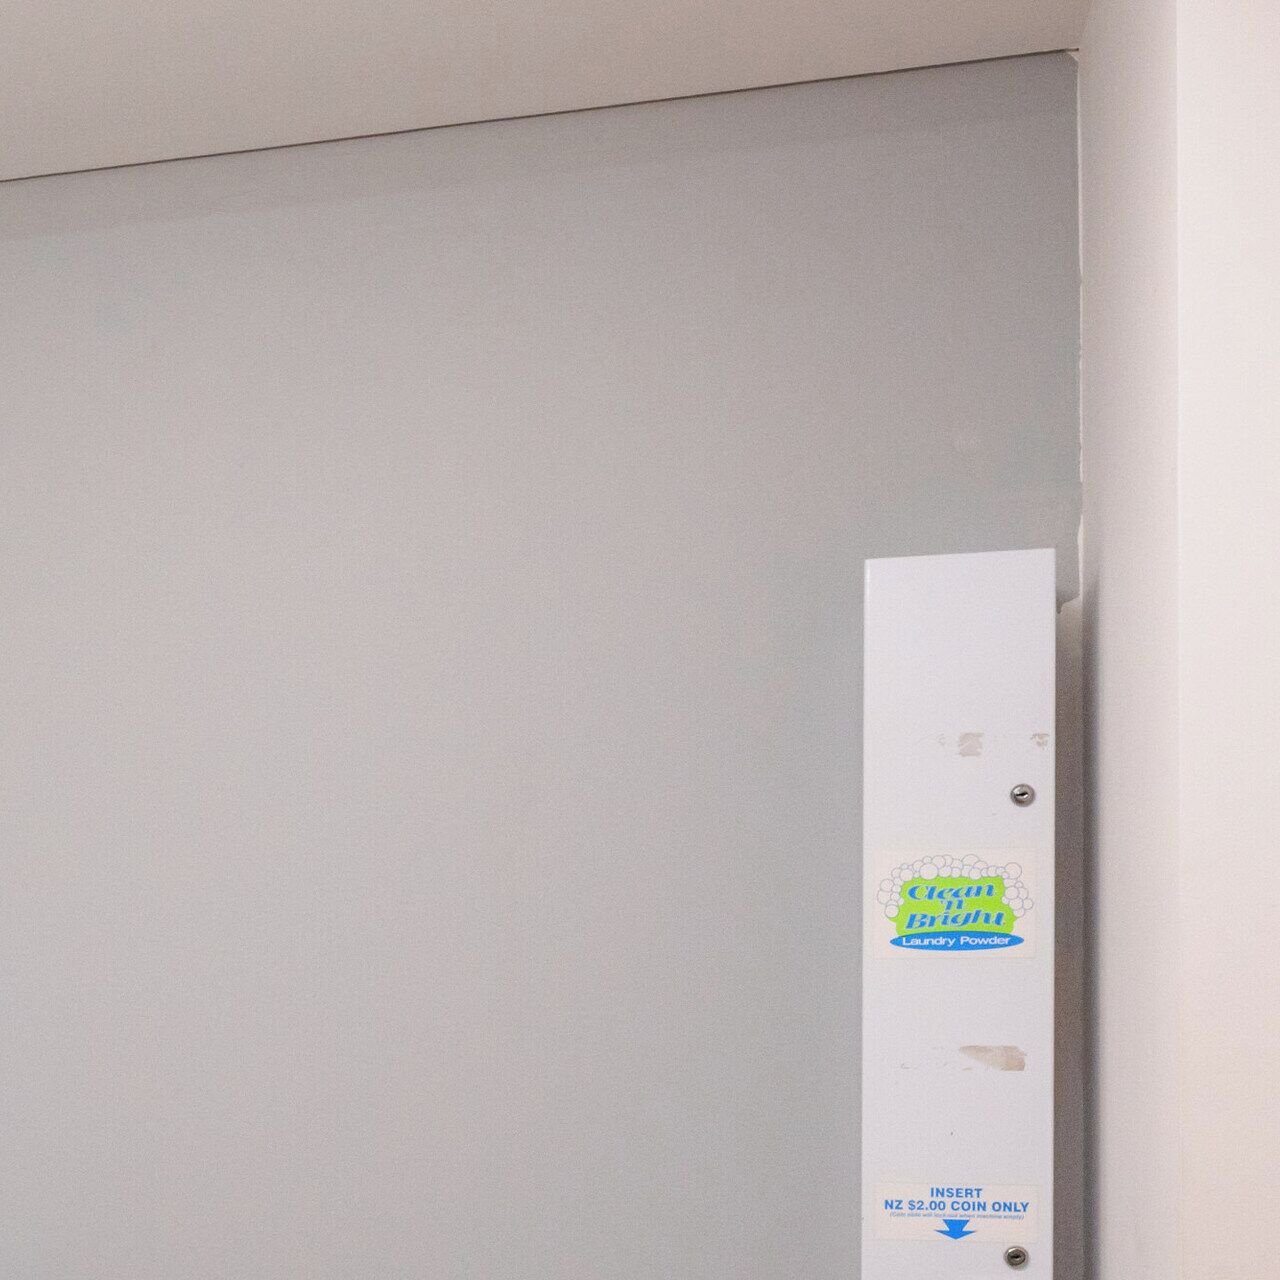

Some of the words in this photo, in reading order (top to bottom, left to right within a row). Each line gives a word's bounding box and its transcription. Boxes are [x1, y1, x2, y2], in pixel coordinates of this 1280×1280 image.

[907, 884, 994, 901] Clean
[905, 909, 1005, 929] Bright
[902, 936, 956, 947] Laundry
[960, 935, 1011, 946] Powder
[930, 1187, 983, 1198] INSERT
[884, 1200, 903, 1210] NZ
[908, 1200, 946, 1211] $2.00
[951, 1201, 987, 1211] COIN
[991, 1201, 1029, 1212] ONLY
